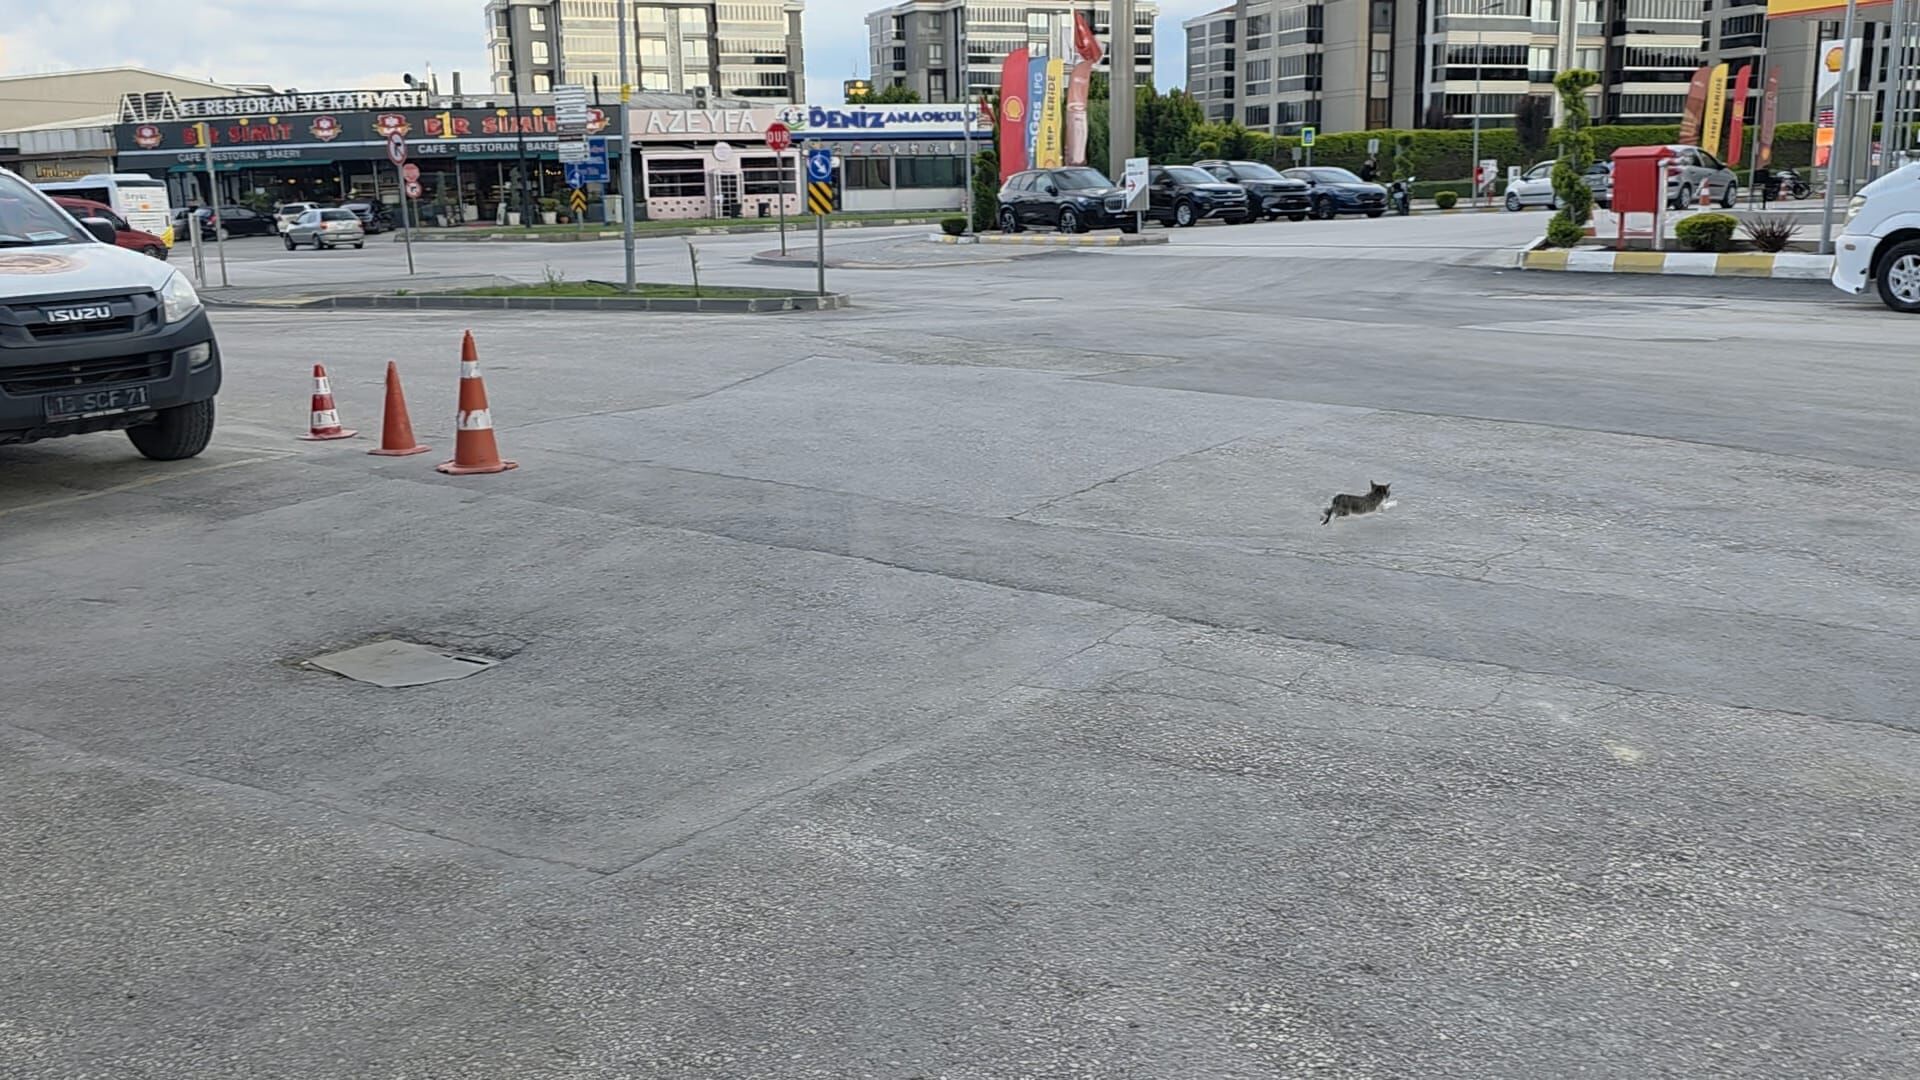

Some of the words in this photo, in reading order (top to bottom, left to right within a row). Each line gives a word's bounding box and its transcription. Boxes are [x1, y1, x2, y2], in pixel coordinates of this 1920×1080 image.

[205, 96, 298, 115] RESTORAN
[646, 110, 758, 134] AZEYFA
[767, 131, 789, 143] DUR
[178, 153, 202, 163] CAFE
[266, 149, 301, 159] BAKERY
[418, 144, 447, 154] CAFE
[459, 142, 518, 153] RESTORAN
[48, 306, 110, 322] ISUZU
[83, 390, 120, 411] SCF
